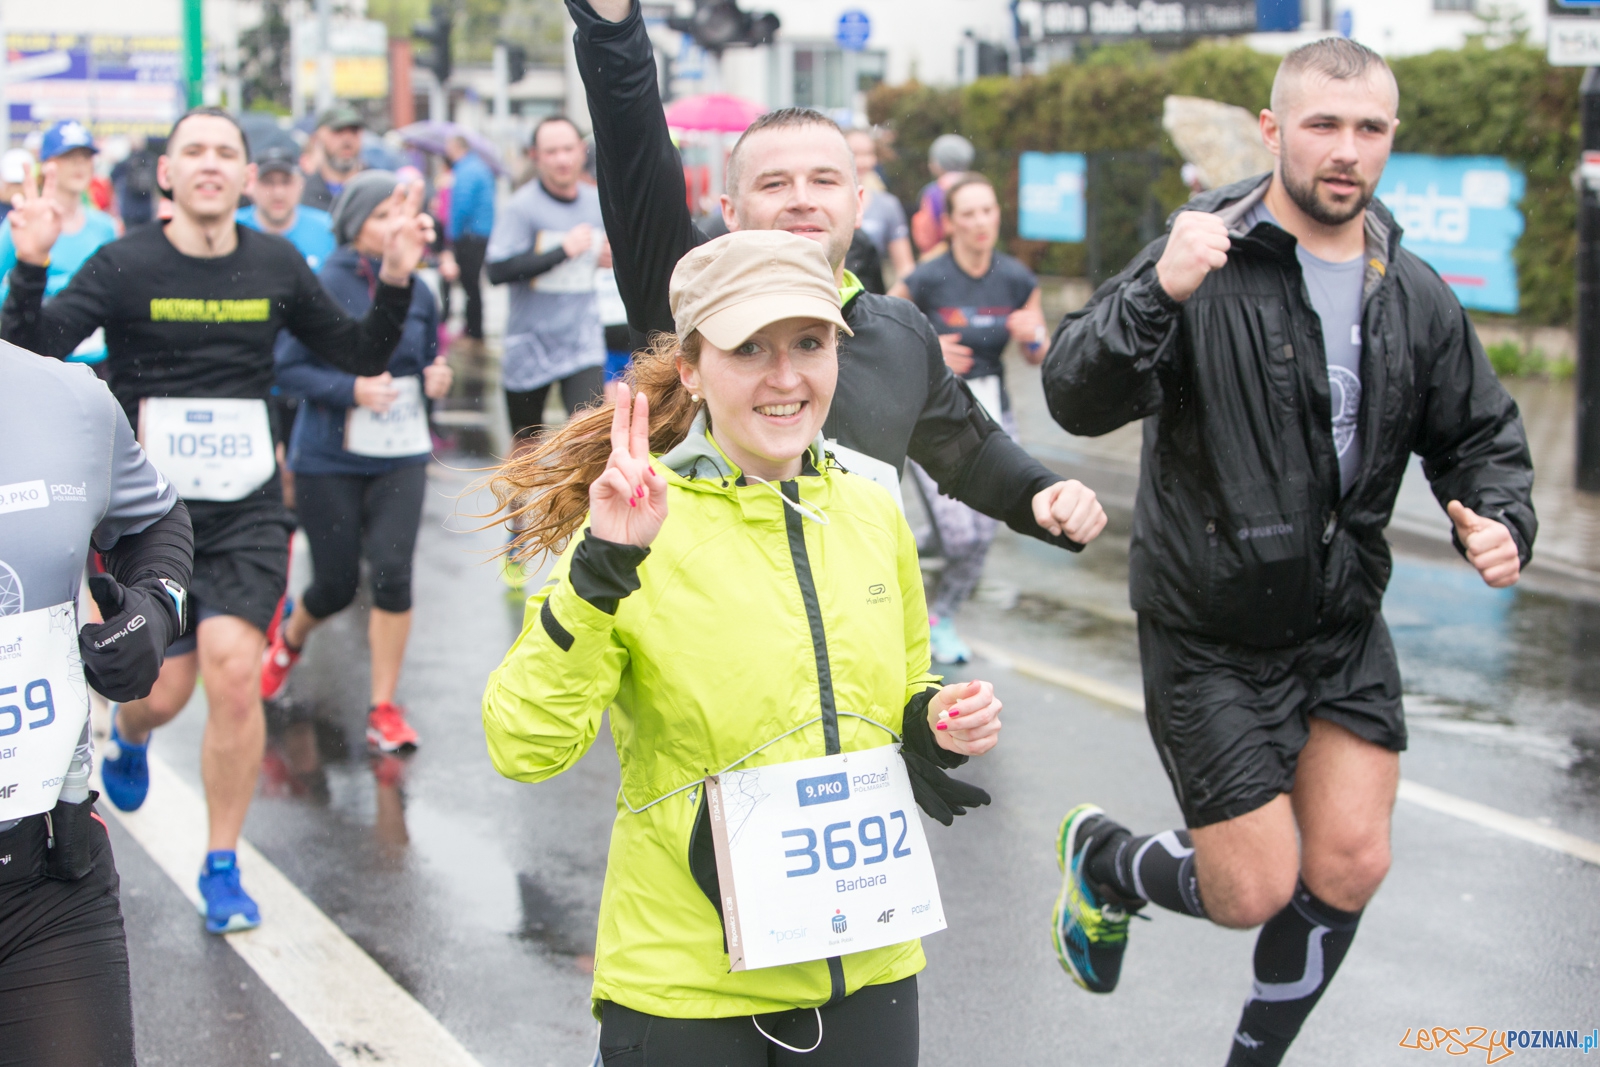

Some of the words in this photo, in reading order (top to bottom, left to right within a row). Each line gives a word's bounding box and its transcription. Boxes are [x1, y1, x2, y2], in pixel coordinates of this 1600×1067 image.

[167, 433, 253, 458] 10583
[805, 780, 843, 798] 9.PKO
[781, 809, 912, 878] 3692
[835, 874, 887, 893] Barbara
